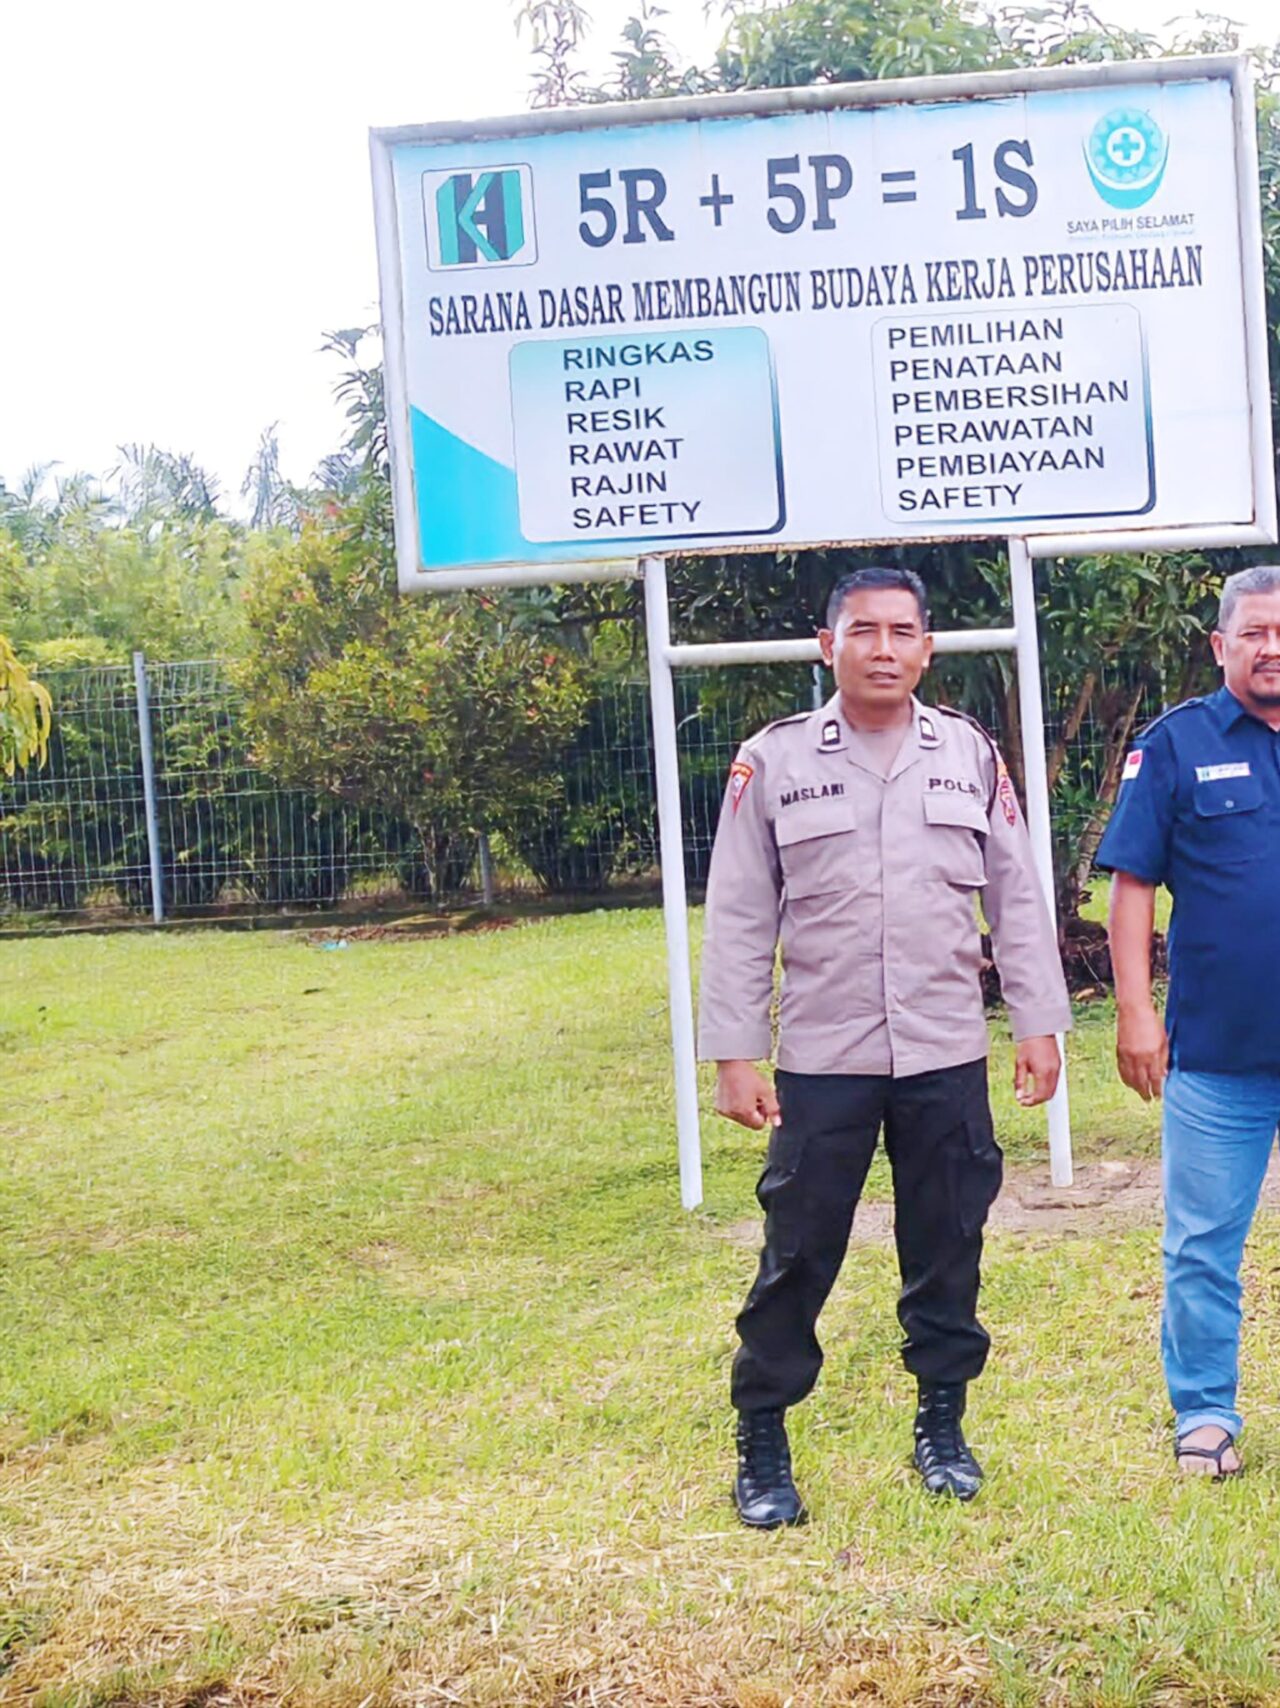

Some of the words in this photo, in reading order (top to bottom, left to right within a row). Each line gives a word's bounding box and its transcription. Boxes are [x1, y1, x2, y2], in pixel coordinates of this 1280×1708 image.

[578, 168, 675, 249] 5R
[766, 153, 853, 234] 5P
[952, 139, 1039, 221] 1S
[1067, 219, 1099, 234] SAYA
[1101, 217, 1133, 231] PILIH
[1136, 213, 1195, 229] SELAMAT
[429, 290, 532, 336] SARANA
[540, 284, 624, 329] DASAR
[632, 271, 801, 322] MEMBANGUN
[811, 264, 918, 311] BUDAYA
[925, 257, 1015, 302] KERJA
[1024, 245, 1203, 296] PERUSAHAAN
[888, 318, 1064, 350] PEMILIHAN
[563, 339, 714, 371] RINGKAS
[890, 352, 1062, 382] PENATAAN
[565, 377, 641, 402] RAPI
[892, 380, 1129, 414] PEMBERSIHAN
[567, 407, 666, 434] RESIK
[895, 415, 1093, 447] PERAWATAN
[569, 438, 684, 466] RAWAT
[897, 447, 1105, 479] PEMBIAYAAN
[571, 470, 667, 498] RAJIN
[899, 483, 1023, 511] SAFETY
[572, 501, 701, 529] SAFETY
